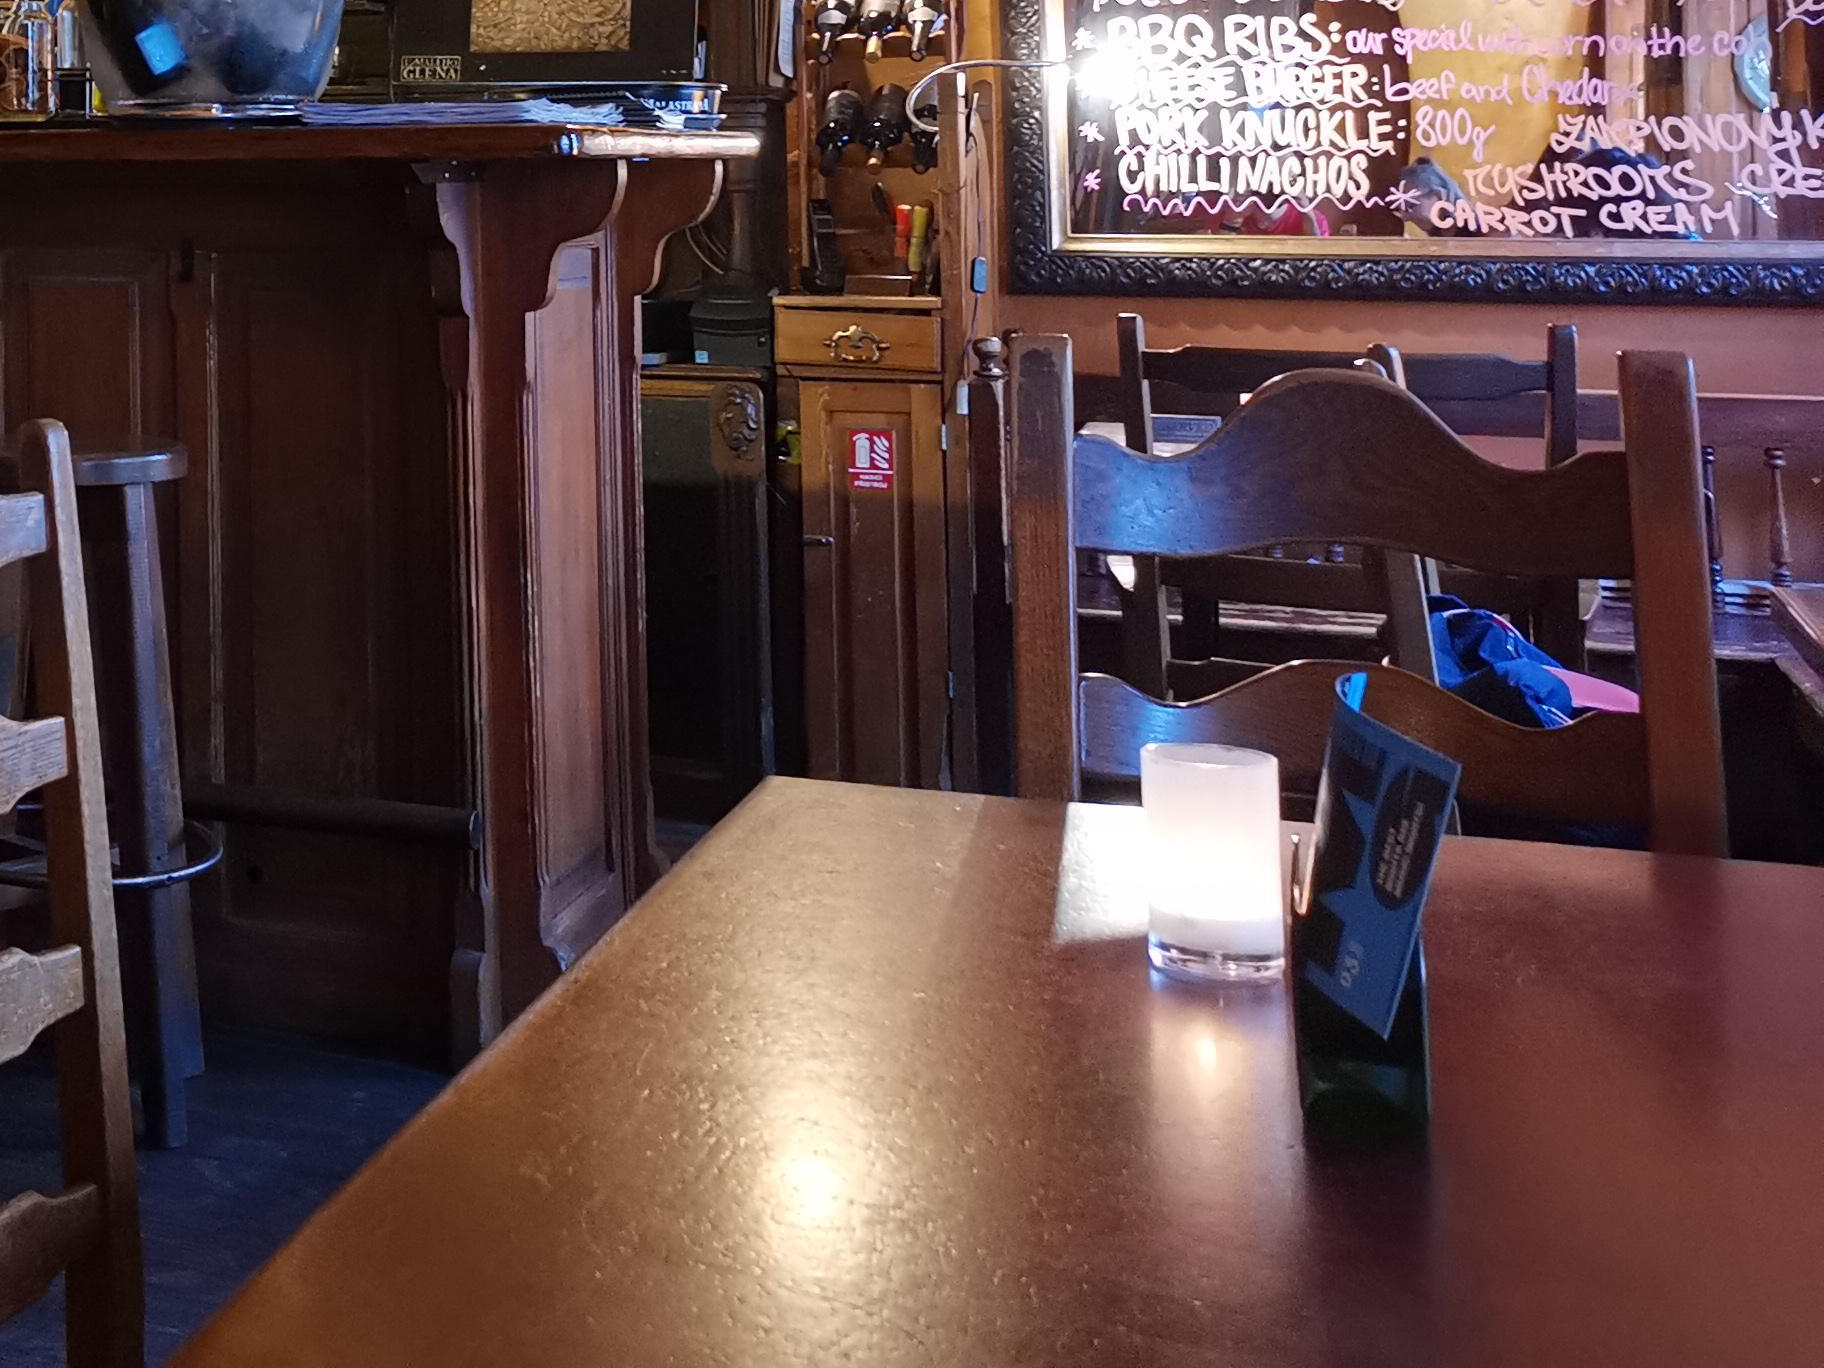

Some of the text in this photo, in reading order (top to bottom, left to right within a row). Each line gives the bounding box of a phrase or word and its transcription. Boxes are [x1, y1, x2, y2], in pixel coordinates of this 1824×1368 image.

[1107, 14, 1216, 59] BBQ
[1346, 28, 1387, 54] our
[1392, 19, 1474, 64] special
[1647, 24, 1704, 57] the
[403, 66, 456, 79] GLENA
[1118, 65, 1237, 102] HEESE
[1382, 64, 1455, 103] beef
[1460, 73, 1512, 103] and
[1114, 108, 1210, 147] PORK
[1415, 107, 1496, 162] 800g
[1118, 152, 1370, 199] CHILLI NACHOS
[1463, 158, 1714, 202] MUSHROOMS
[1430, 200, 1741, 238] CARROT CREAM
